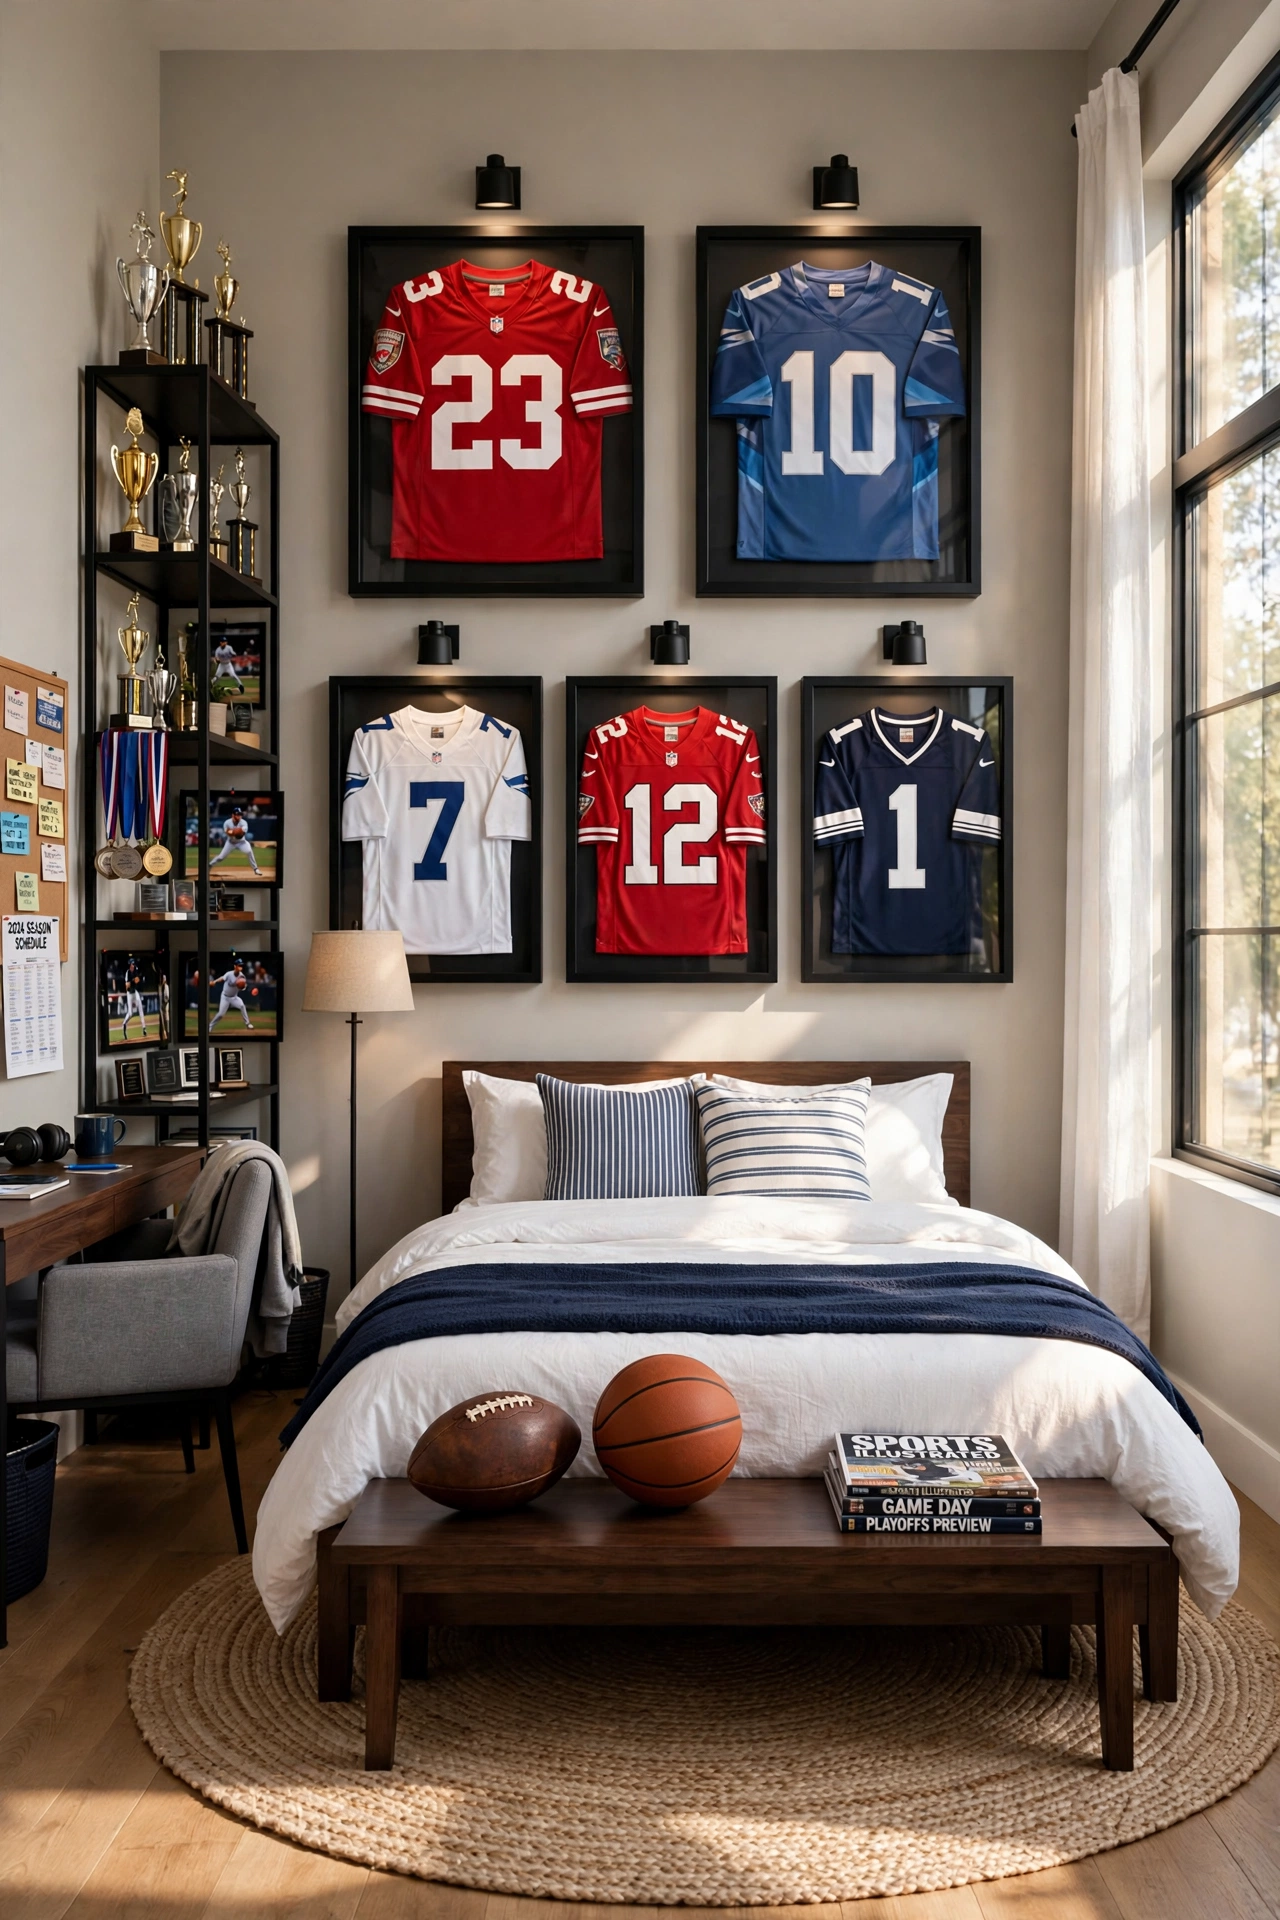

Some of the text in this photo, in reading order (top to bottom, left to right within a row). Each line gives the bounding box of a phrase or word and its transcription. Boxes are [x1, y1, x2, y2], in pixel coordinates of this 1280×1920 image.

[403, 270, 444, 303] 3
[550, 270, 593, 303] 2
[891, 271, 935, 306] 1
[431, 354, 563, 470] 23
[780, 350, 896, 476] 10
[479, 713, 512, 739] 7
[595, 714, 628, 744] 2
[829, 718, 863, 745] 1
[951, 718, 985, 743] 1
[409, 781, 465, 881] 7
[624, 783, 718, 885] 12
[888, 784, 926, 889] 1
[8, 921, 52, 935] 2024 SEASON
[15, 936, 47, 950] SCHEDULE
[851, 1435, 998, 1452] SPORTS
[854, 1449, 1001, 1459] ILLUSTRATED
[882, 1498, 973, 1515] GAME DAY
[866, 1517, 992, 1532] PLAYOFFS PREVIEW
